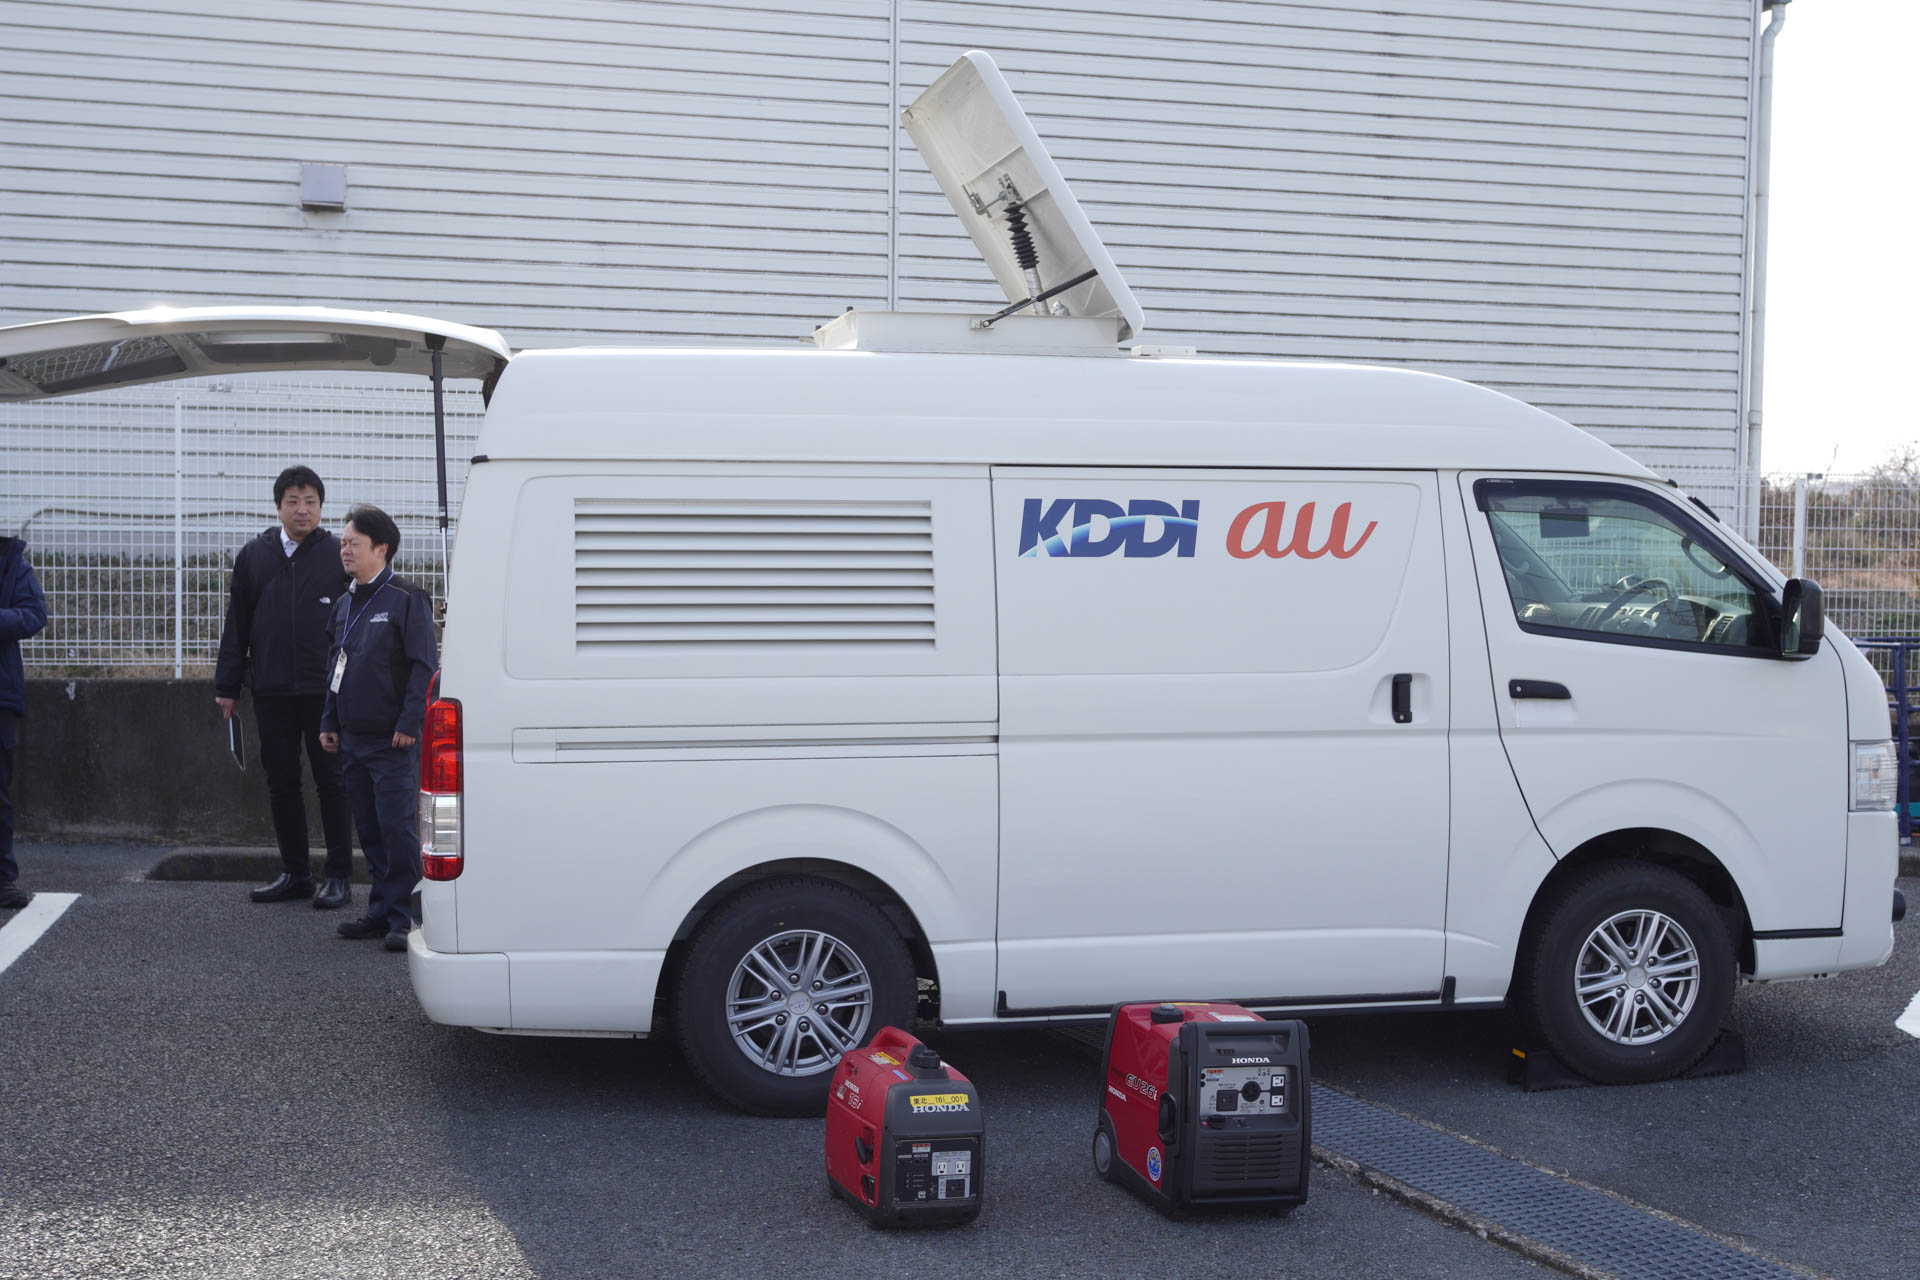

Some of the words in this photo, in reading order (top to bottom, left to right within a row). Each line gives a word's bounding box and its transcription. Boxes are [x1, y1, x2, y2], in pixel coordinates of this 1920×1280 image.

[1018, 498, 1200, 558] KDDI
[1226, 501, 1378, 560] au
[1126, 1073, 1158, 1101] EU26i
[848, 1092, 864, 1110] 16i
[912, 1103, 970, 1114] HONDA
